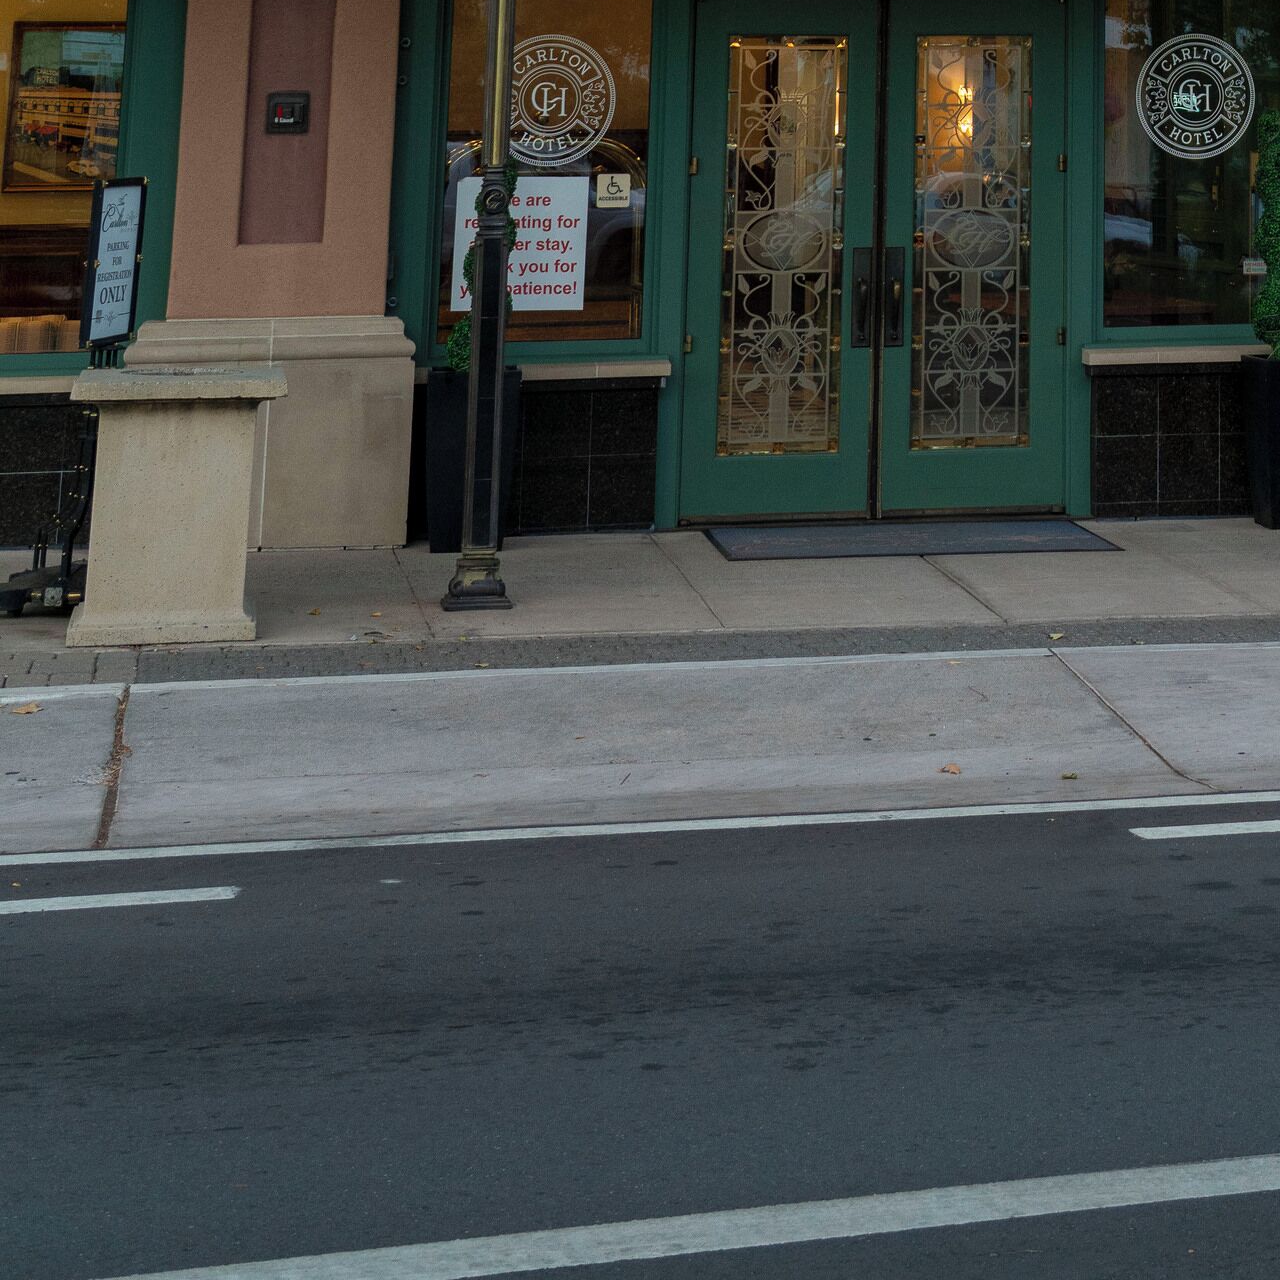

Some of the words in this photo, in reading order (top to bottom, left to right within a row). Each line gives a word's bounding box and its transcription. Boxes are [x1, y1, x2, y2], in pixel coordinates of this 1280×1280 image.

[513, 48, 591, 76] CARLTON
[1161, 46, 1232, 73] CARLTON
[519, 131, 579, 152] HOTEL
[1169, 126, 1224, 145] HOTEL
[526, 196, 552, 207] are
[464, 215, 552, 232] reating
[557, 215, 581, 228] for
[107, 240, 130, 252] PARKING
[536, 238, 573, 254] stay.
[112, 255, 122, 266] FOR
[519, 262, 549, 277] you
[554, 259, 578, 273] for
[97, 269, 132, 282] REGISTRATION
[100, 284, 128, 305] ONLY
